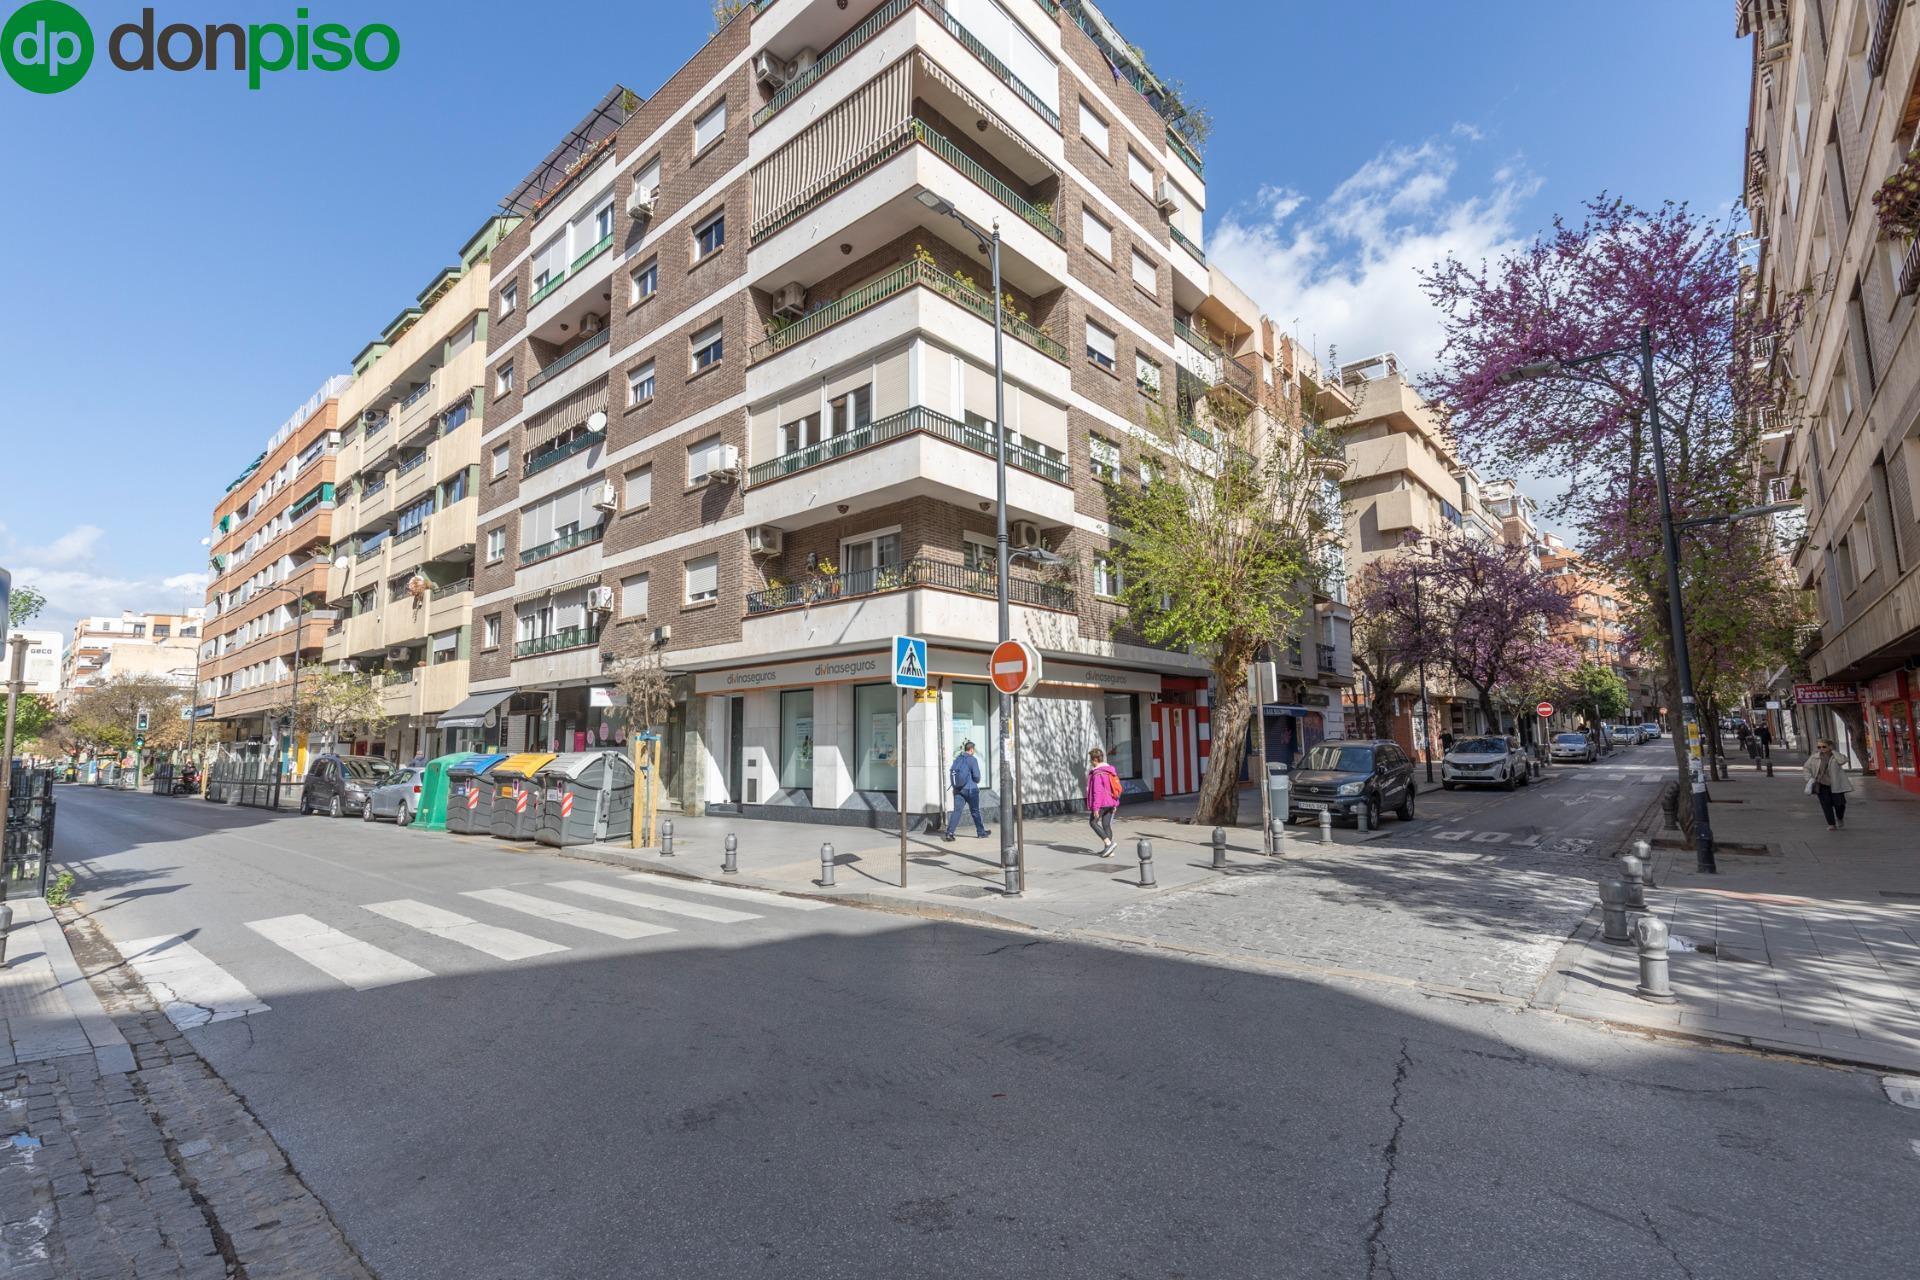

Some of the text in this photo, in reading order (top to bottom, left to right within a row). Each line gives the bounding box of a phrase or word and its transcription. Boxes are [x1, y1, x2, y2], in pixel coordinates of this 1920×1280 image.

[814, 659, 877, 676] divinaseguros
[726, 670, 777, 685] divinaseguros
[1796, 687, 1847, 699] Francis
